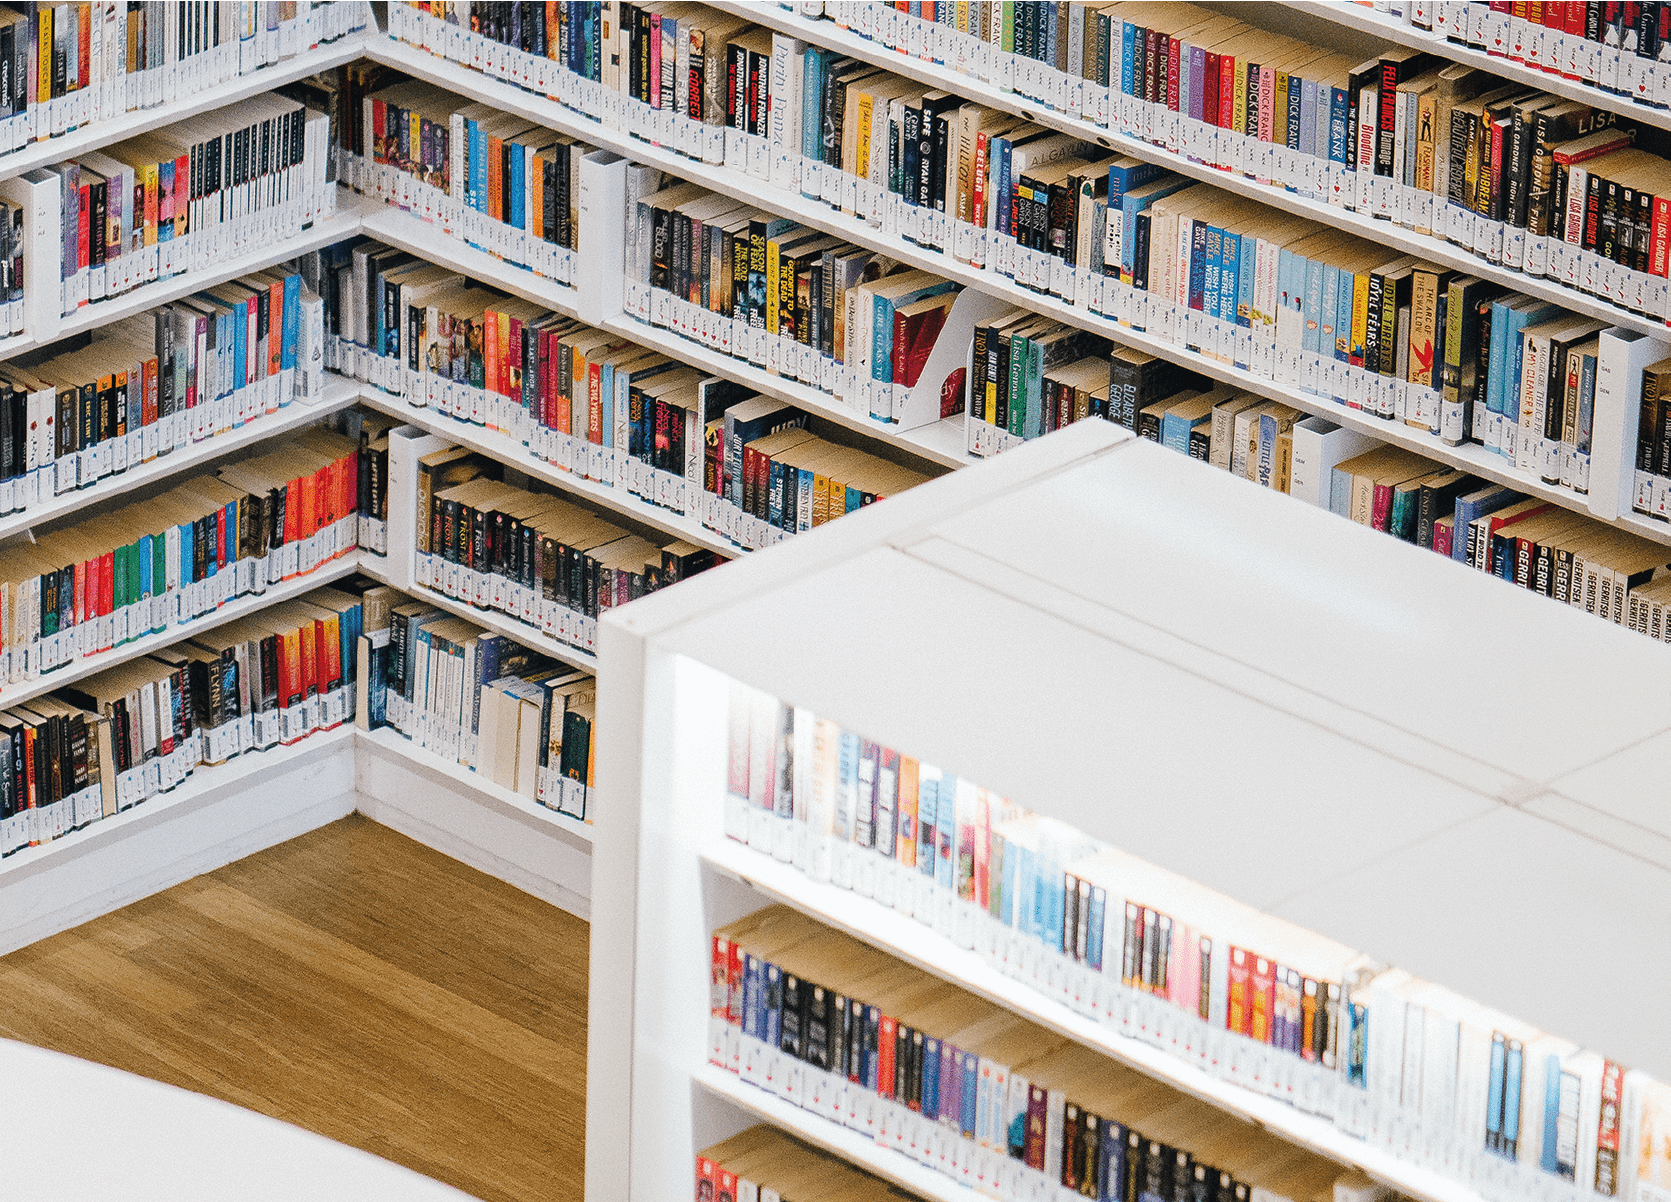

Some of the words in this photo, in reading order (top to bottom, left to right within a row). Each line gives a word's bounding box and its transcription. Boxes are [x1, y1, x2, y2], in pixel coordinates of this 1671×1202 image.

[1038, 10, 1047, 32] DICK
[92, 30, 101, 57] CRY
[757, 57, 768, 98] JONATHAN
[774, 43, 789, 91] Purity
[1383, 65, 1396, 91] FELIX
[1, 60, 10, 107] crescendo
[1261, 89, 1270, 111] DICK
[1289, 96, 1299, 118] DICK
[1381, 92, 1394, 130] FRANCIS
[922, 109, 931, 136] SAFE
[1535, 119, 1546, 143] LISA
[1332, 119, 1344, 157] FRANK
[1360, 125, 1374, 165] Bloodline
[1379, 131, 1393, 165] Damage
[921, 158, 929, 181] RYAN
[960, 136, 972, 190] HILLTOP
[975, 150, 985, 193] BELUGA
[1466, 146, 1474, 179] GARCIA
[1532, 149, 1543, 200] GARDNER
[1111, 177, 1122, 205] mike
[1570, 198, 1581, 213] LISA
[1032, 204, 1040, 231] GAYLIN
[1114, 216, 1122, 235] seeing
[1529, 209, 1538, 234] FIND
[1567, 213, 1580, 243] GARDNER
[1657, 223, 1667, 238] LISA
[654, 227, 664, 258] BLOOD
[751, 234, 758, 246] OF
[1107, 223, 1115, 249] people
[1228, 239, 1236, 261] MIKE
[757, 237, 765, 272] SEASON
[1222, 237, 1230, 265] GAYLE
[1655, 239, 1666, 272] GARDNER
[740, 261, 748, 282] COLD
[1227, 272, 1235, 295] WISH
[787, 300, 794, 310] TO
[1226, 296, 1234, 315] YOU
[1369, 278, 1379, 309] IDYLL
[1383, 283, 1393, 314] IDYLL
[1353, 289, 1362, 338] COMMITMENT
[1415, 293, 1423, 333] SWALLOW
[975, 331, 987, 359] TROY
[1367, 314, 1378, 347] FEARS
[1381, 319, 1391, 365] THREATS
[988, 350, 997, 363] JEAN
[1012, 339, 1022, 361] Lisa
[1527, 354, 1535, 367] MY
[987, 364, 996, 382] GENET
[1011, 363, 1021, 399] Genova
[1525, 369, 1535, 406] CLEANER
[1570, 374, 1577, 387] MY
[590, 378, 599, 432] NEWLYWEDS
[1109, 384, 1123, 419] GEORGE
[1645, 376, 1656, 405] TROY
[1122, 384, 1136, 428] ELIZABETH
[1567, 389, 1576, 423] DRIVER
[1262, 440, 1271, 464] LITTLE
[444, 516, 453, 546] FROST
[474, 530, 482, 556] FROST
[1572, 561, 1583, 603] GERRITSEN
[211, 667, 220, 707] FLYNN
